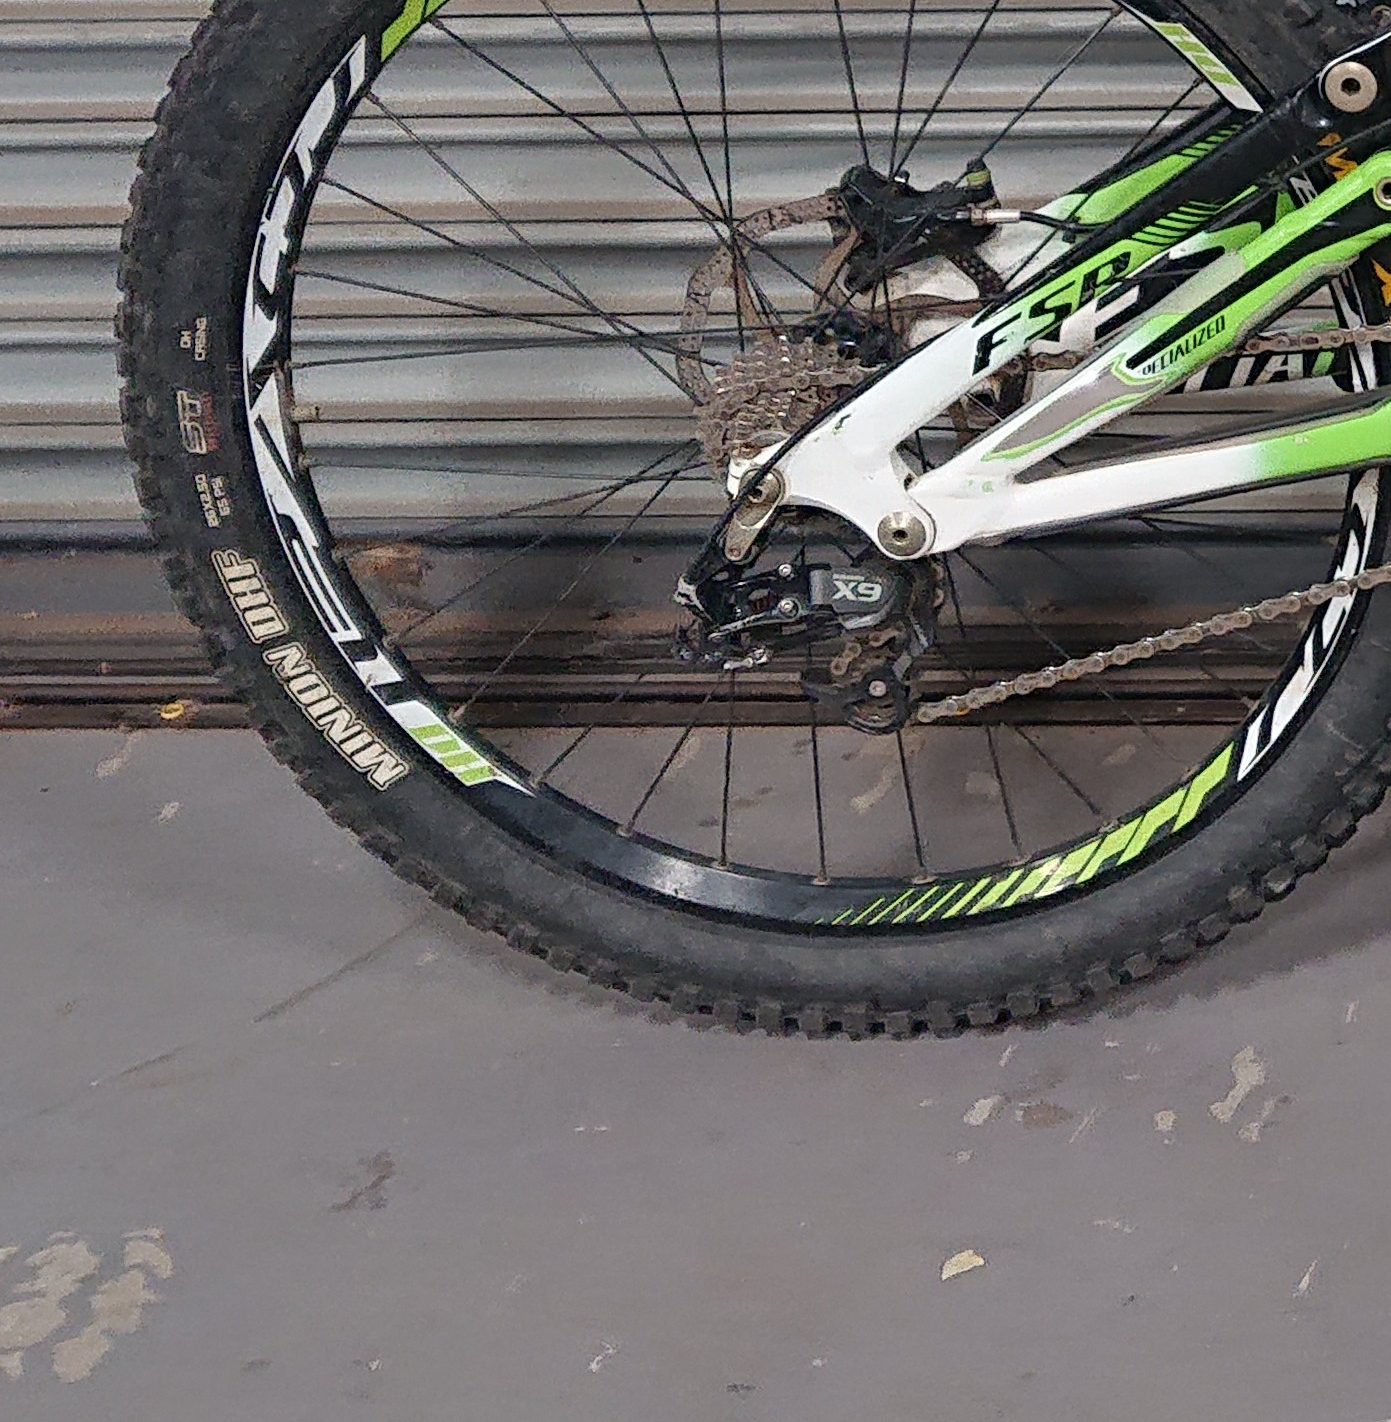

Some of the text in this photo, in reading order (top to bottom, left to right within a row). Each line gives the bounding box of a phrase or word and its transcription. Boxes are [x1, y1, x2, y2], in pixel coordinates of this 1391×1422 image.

[971, 250, 1132, 377] FSR
[832, 579, 882, 603] X9
[210, 549, 411, 792] MINION DHF
